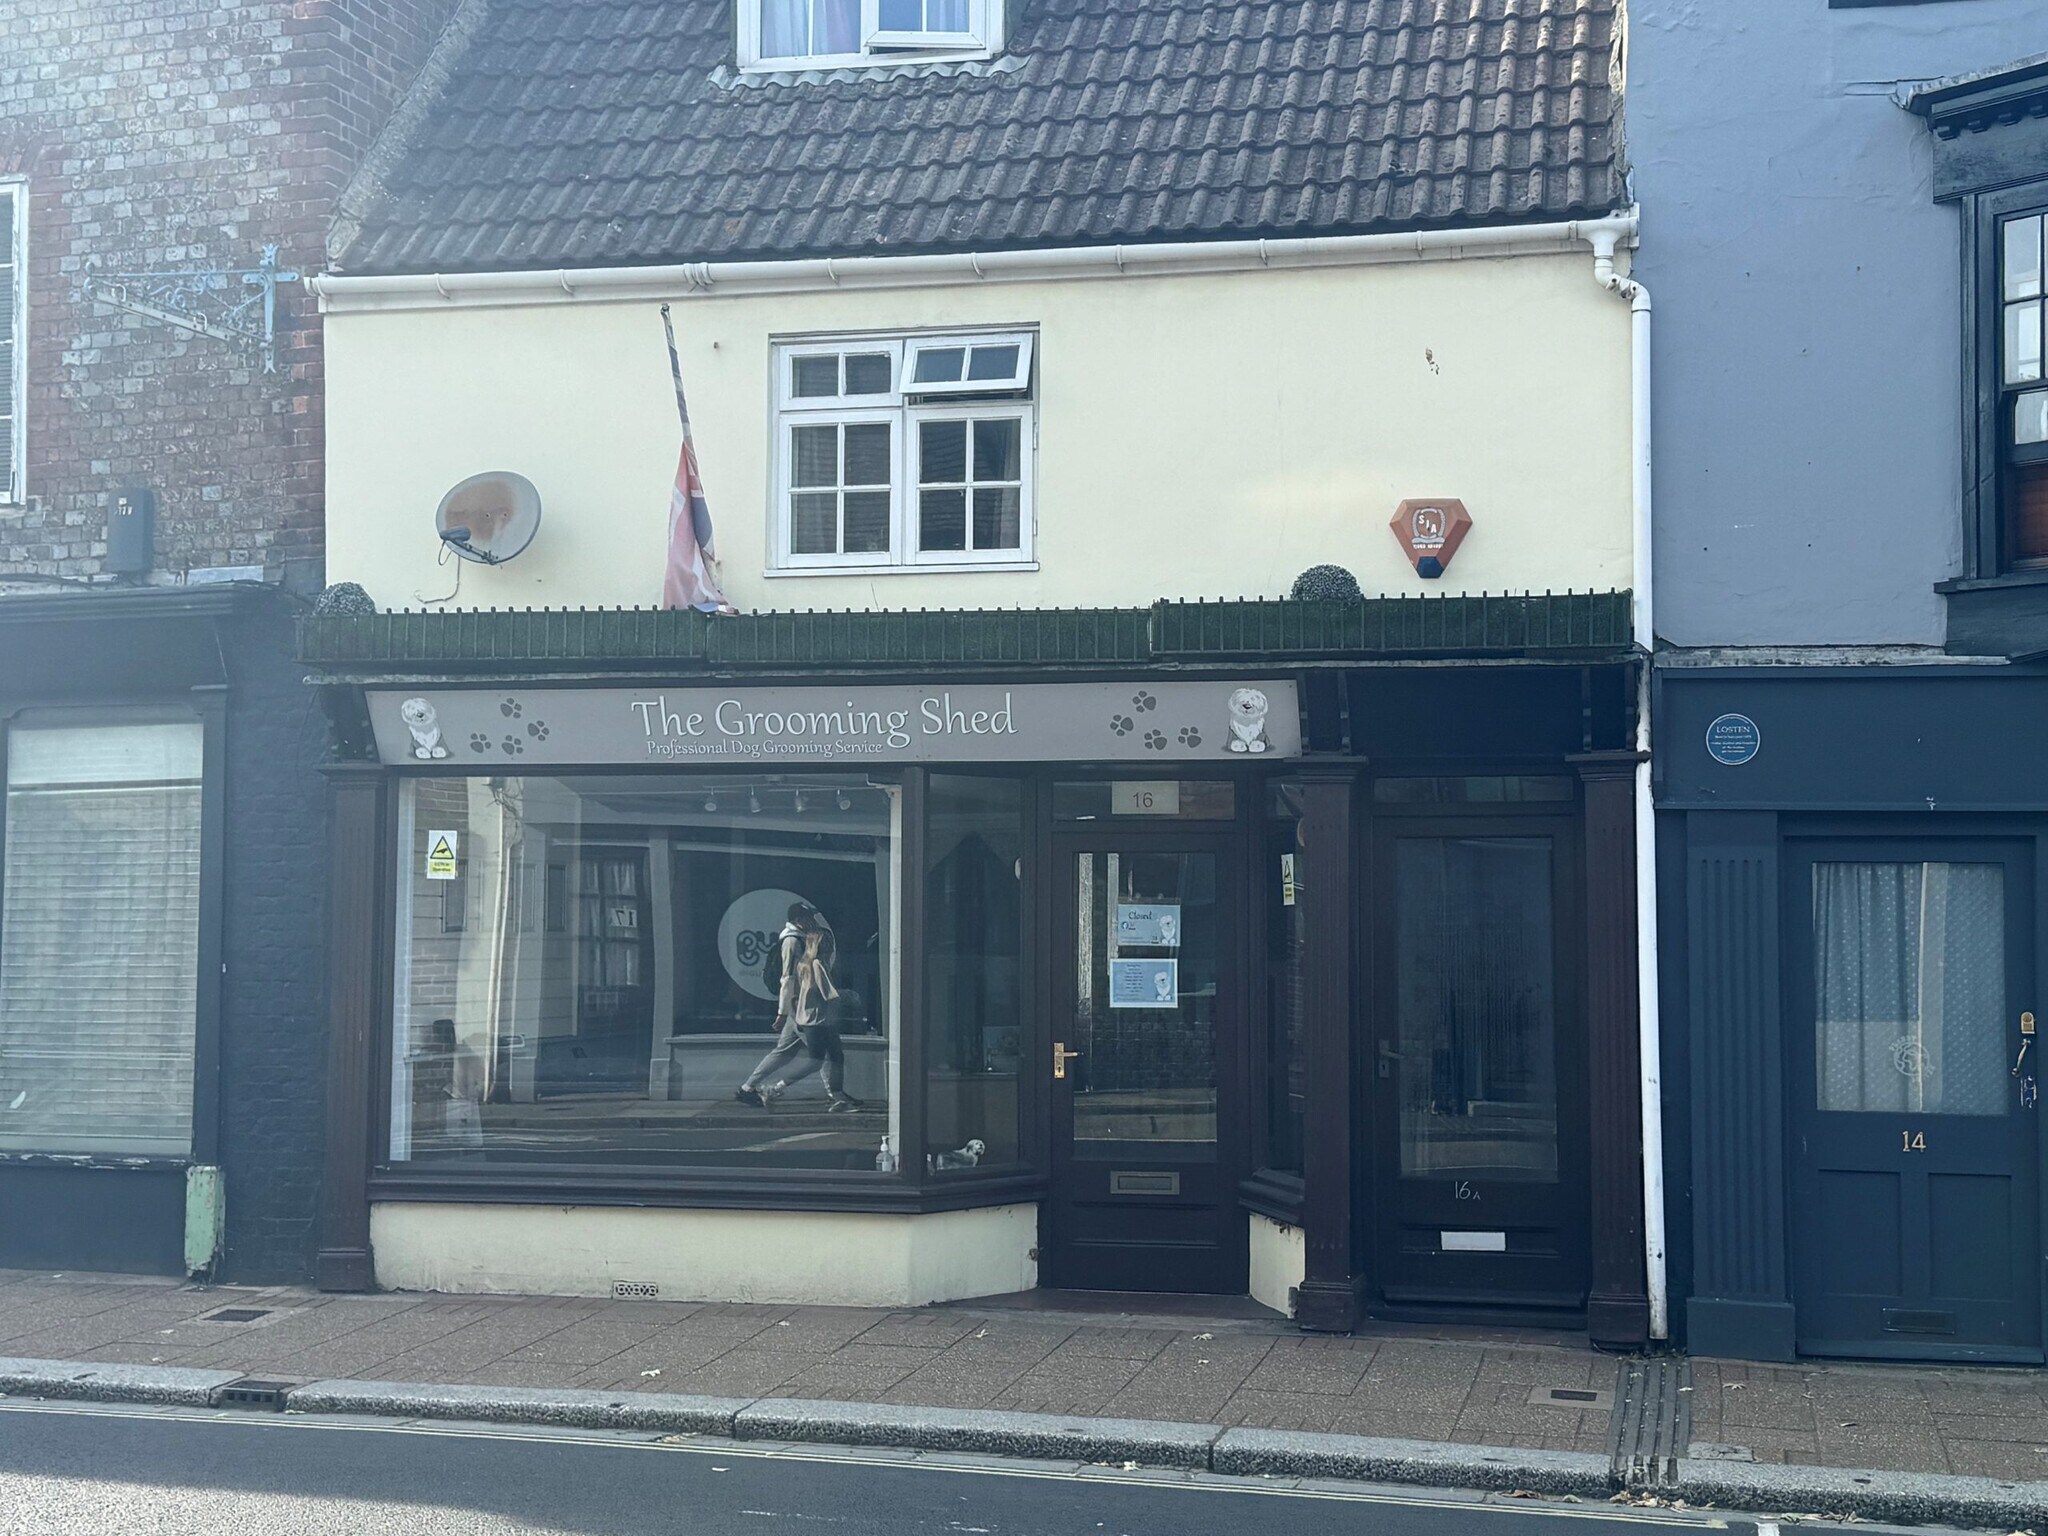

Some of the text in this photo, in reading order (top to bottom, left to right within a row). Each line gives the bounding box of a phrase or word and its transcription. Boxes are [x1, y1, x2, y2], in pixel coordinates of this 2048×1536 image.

[631, 692, 1018, 748] The Grooming Shed
[646, 738, 883, 759] Professional Dog Grooming Service
[1132, 791, 1154, 808] 16
[1902, 1130, 1926, 1153] 14
